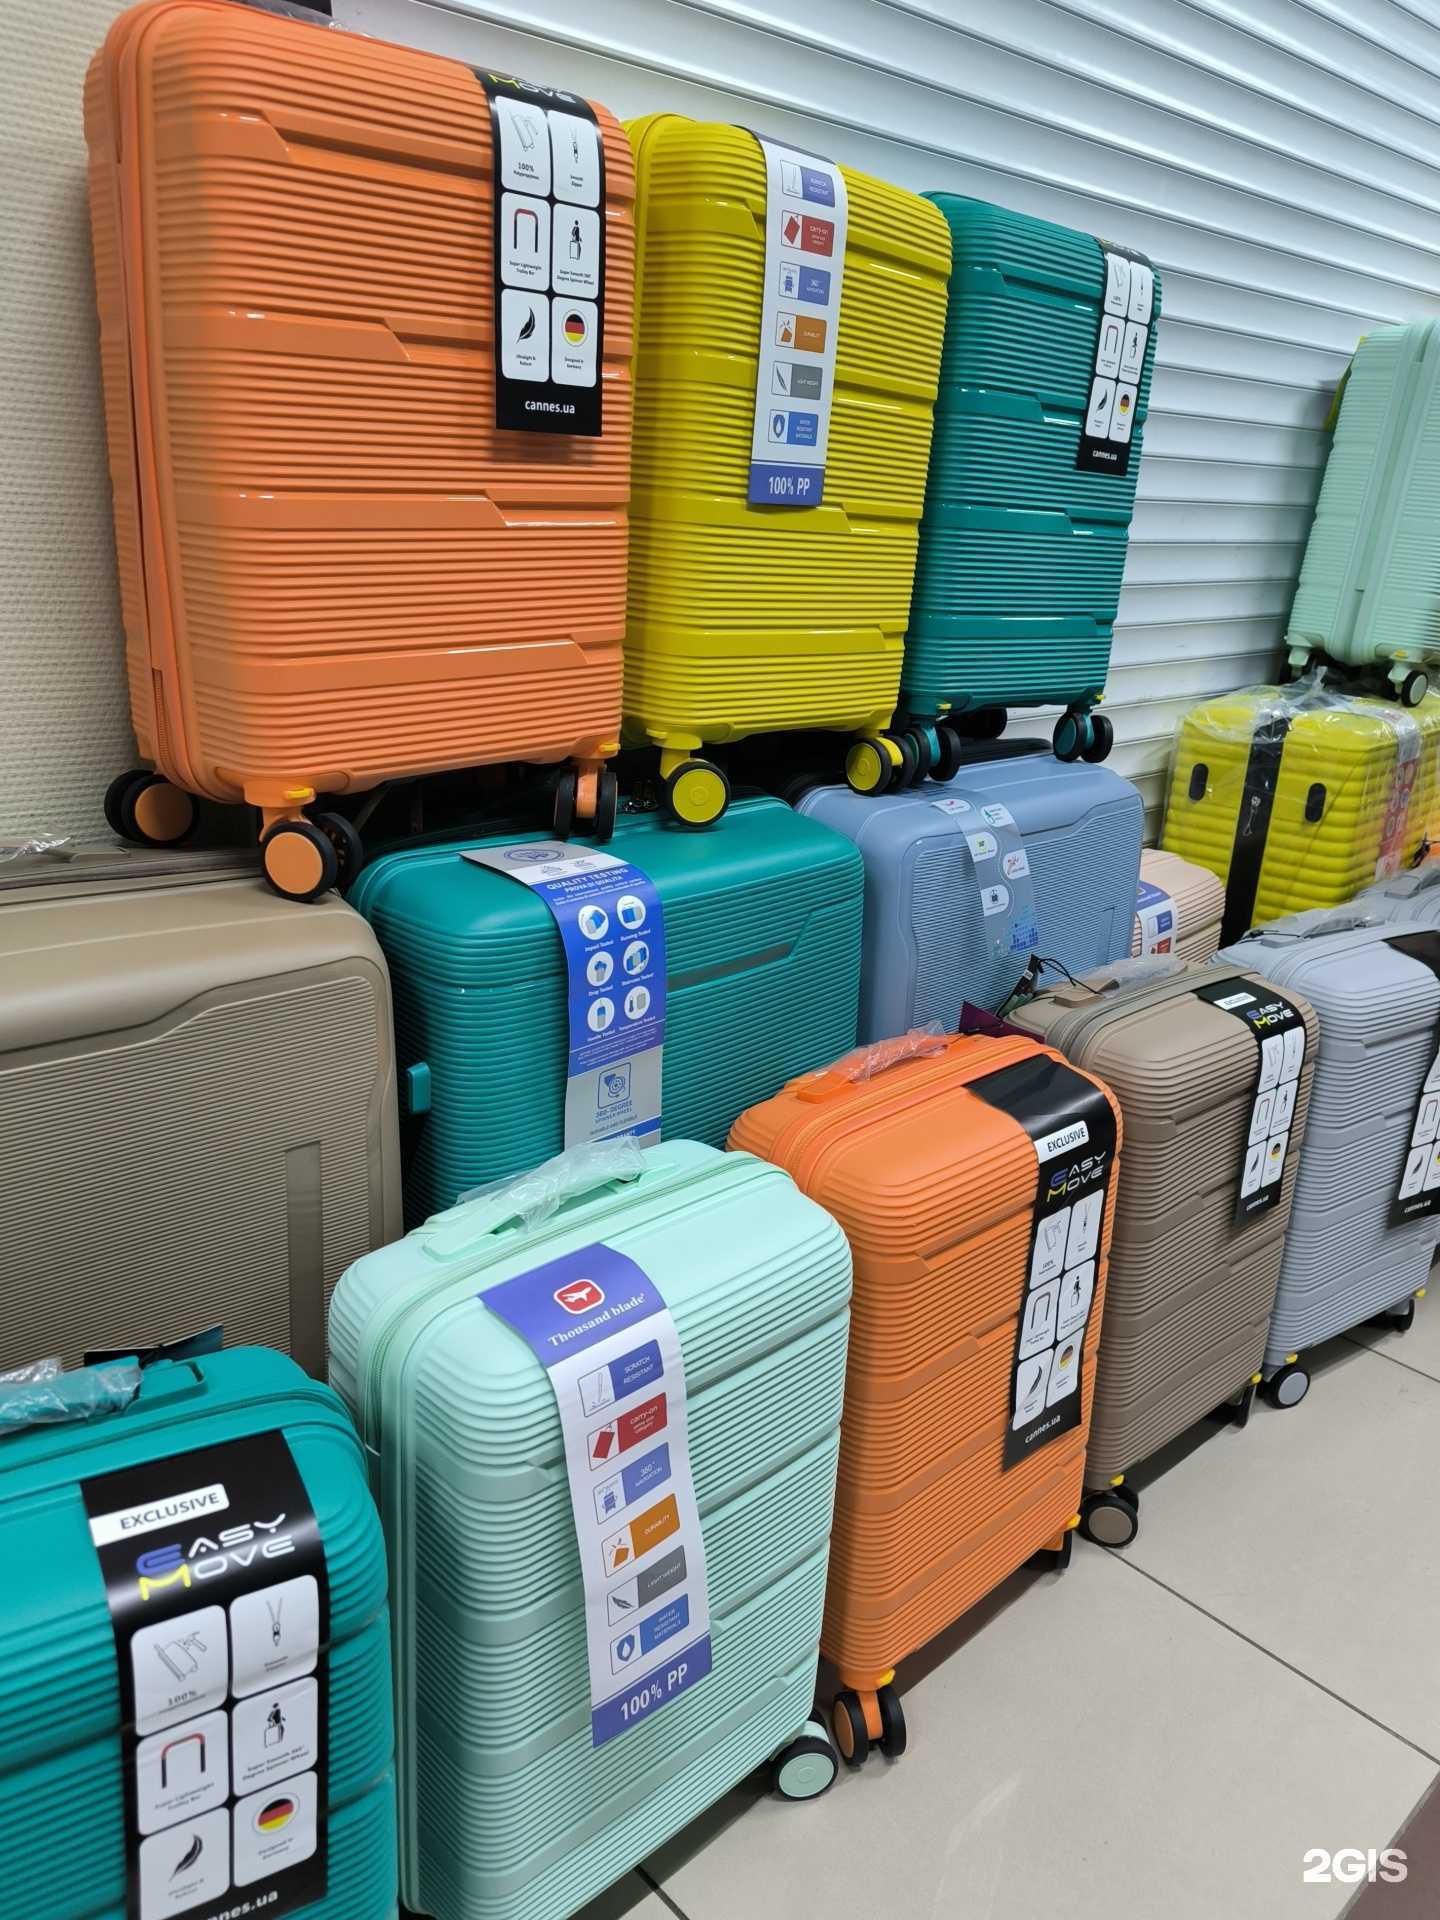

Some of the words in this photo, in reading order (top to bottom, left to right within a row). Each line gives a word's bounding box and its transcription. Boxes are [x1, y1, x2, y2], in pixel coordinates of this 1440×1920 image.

[518, 162, 534, 172] 100%
[525, 400, 575, 414] cannes.ua
[768, 476, 794, 495] 100%
[797, 477, 810, 496] PP
[546, 875, 589, 890] QUALITY
[589, 867, 629, 881] TESTING
[1246, 1001, 1284, 1020] EASY
[1253, 1008, 1294, 1029] MOVE
[1047, 1128, 1086, 1152] EXCLUSIVE
[1047, 1165, 1104, 1202] MOVE
[1051, 1151, 1106, 1187] EASY
[547, 1311, 611, 1347] Thousand
[1025, 1415, 1061, 1444] cannes.ua
[120, 1492, 219, 1530] EXCLUSIVE
[136, 1513, 286, 1576] EASY
[138, 1534, 295, 1601] MOVE
[620, 1680, 662, 1720] 100%
[667, 1663, 688, 1692] PP
